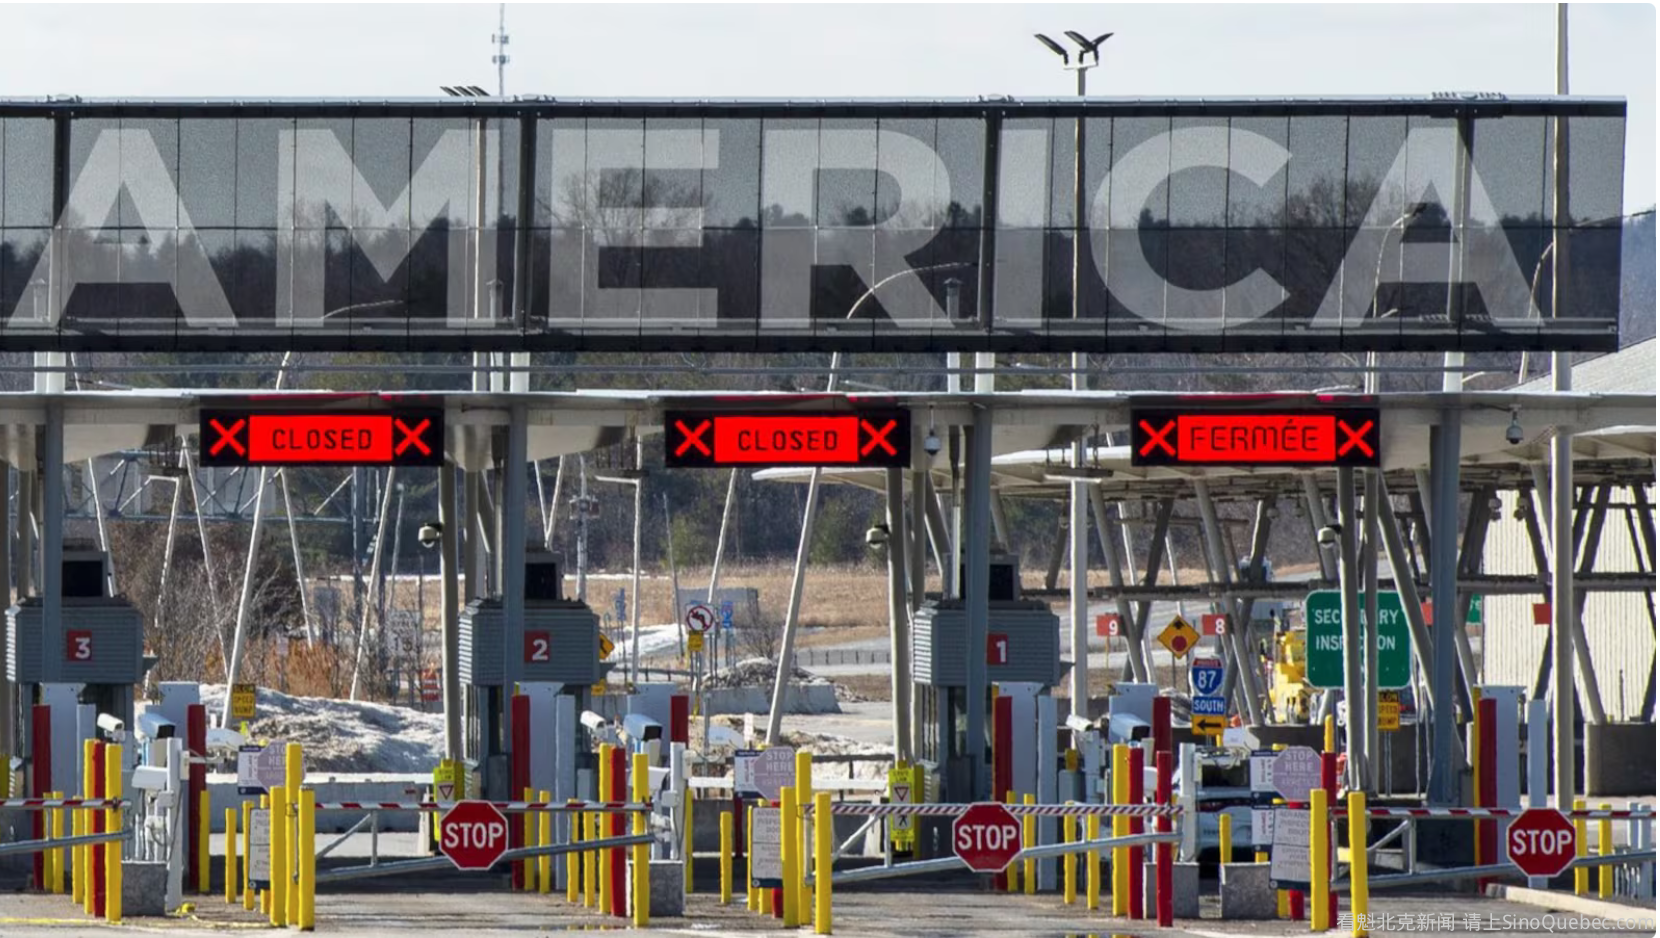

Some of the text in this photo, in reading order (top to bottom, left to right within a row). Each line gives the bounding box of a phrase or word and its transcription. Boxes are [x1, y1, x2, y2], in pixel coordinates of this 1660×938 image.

[8, 126, 1544, 328] AMERICA
[272, 428, 373, 451] CLOSED
[738, 430, 839, 452] CLOSED
[1190, 418, 1318, 452] FERMÉE
[1215, 618, 1226, 635] 8
[1314, 608, 1399, 625] SECRY
[1108, 619, 1119, 637] 9
[75, 637, 91, 660] 3
[531, 638, 549, 660] 2
[996, 640, 1007, 663] 1
[1315, 635, 1396, 651] INSON
[1198, 670, 1217, 689] 87
[1194, 699, 1224, 712] SOUTH
[766, 750, 793, 760] STOP
[1285, 750, 1313, 760] STOP
[766, 761, 794, 772] HERE
[1284, 761, 1314, 773] HERE
[445, 822, 503, 850] STOP
[957, 825, 1017, 851] STOP
[1511, 830, 1573, 857] STOP
